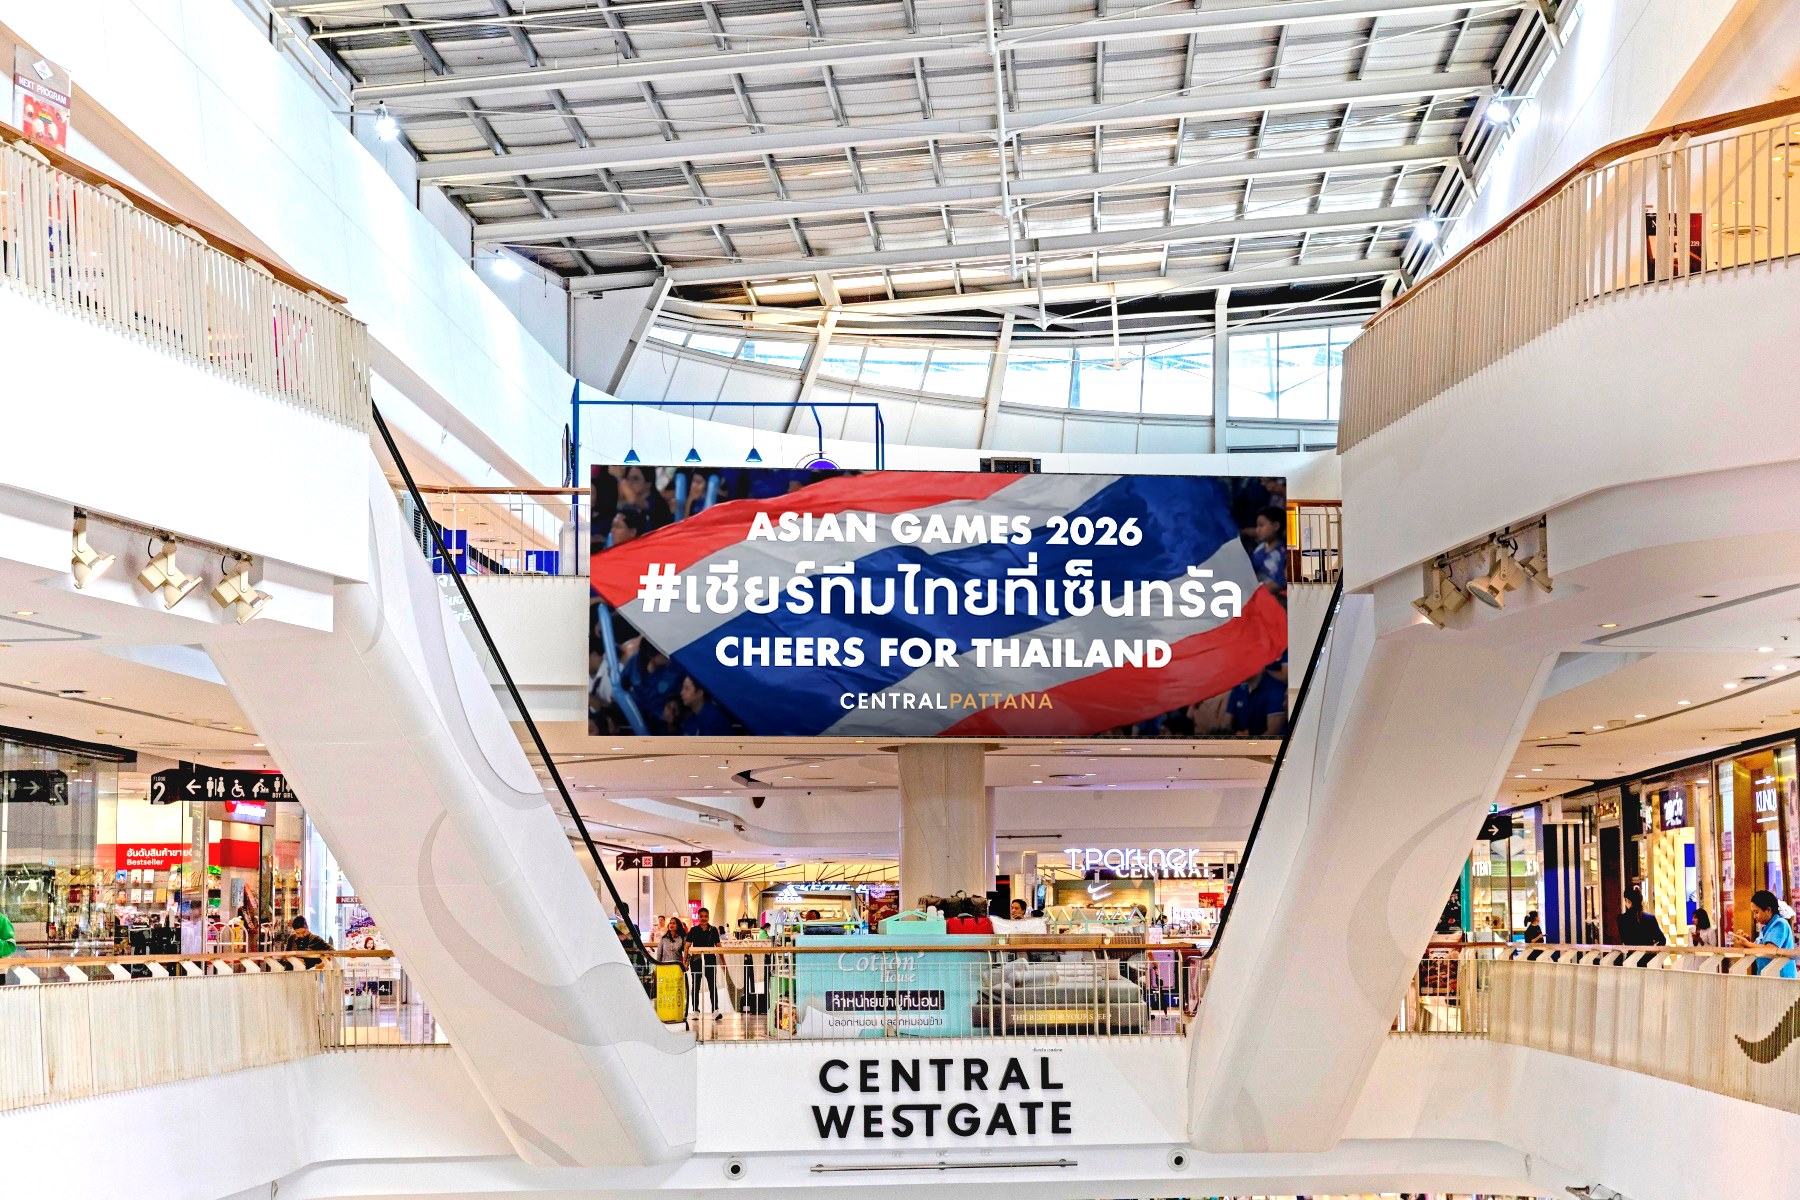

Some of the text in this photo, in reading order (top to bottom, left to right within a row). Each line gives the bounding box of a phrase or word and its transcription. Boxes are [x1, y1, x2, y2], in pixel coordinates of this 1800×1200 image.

[18, 75, 67, 106] NEXT PROGRAM
[746, 511, 1143, 547] ASIAN GAMES 2026
[637, 551, 1243, 618] #เชียร์ทีมไทยที่เซ็นทรัล
[715, 635, 1173, 669] CHEERS FOR THAILAND
[839, 692, 1054, 711] CENTRALPATTANA
[153, 781, 166, 805] 2
[126, 858, 164, 866] Bestseller
[617, 859, 625, 871] 2
[818, 1056, 1064, 1094] CENTRAL
[811, 1100, 1073, 1139] WESTGATE
